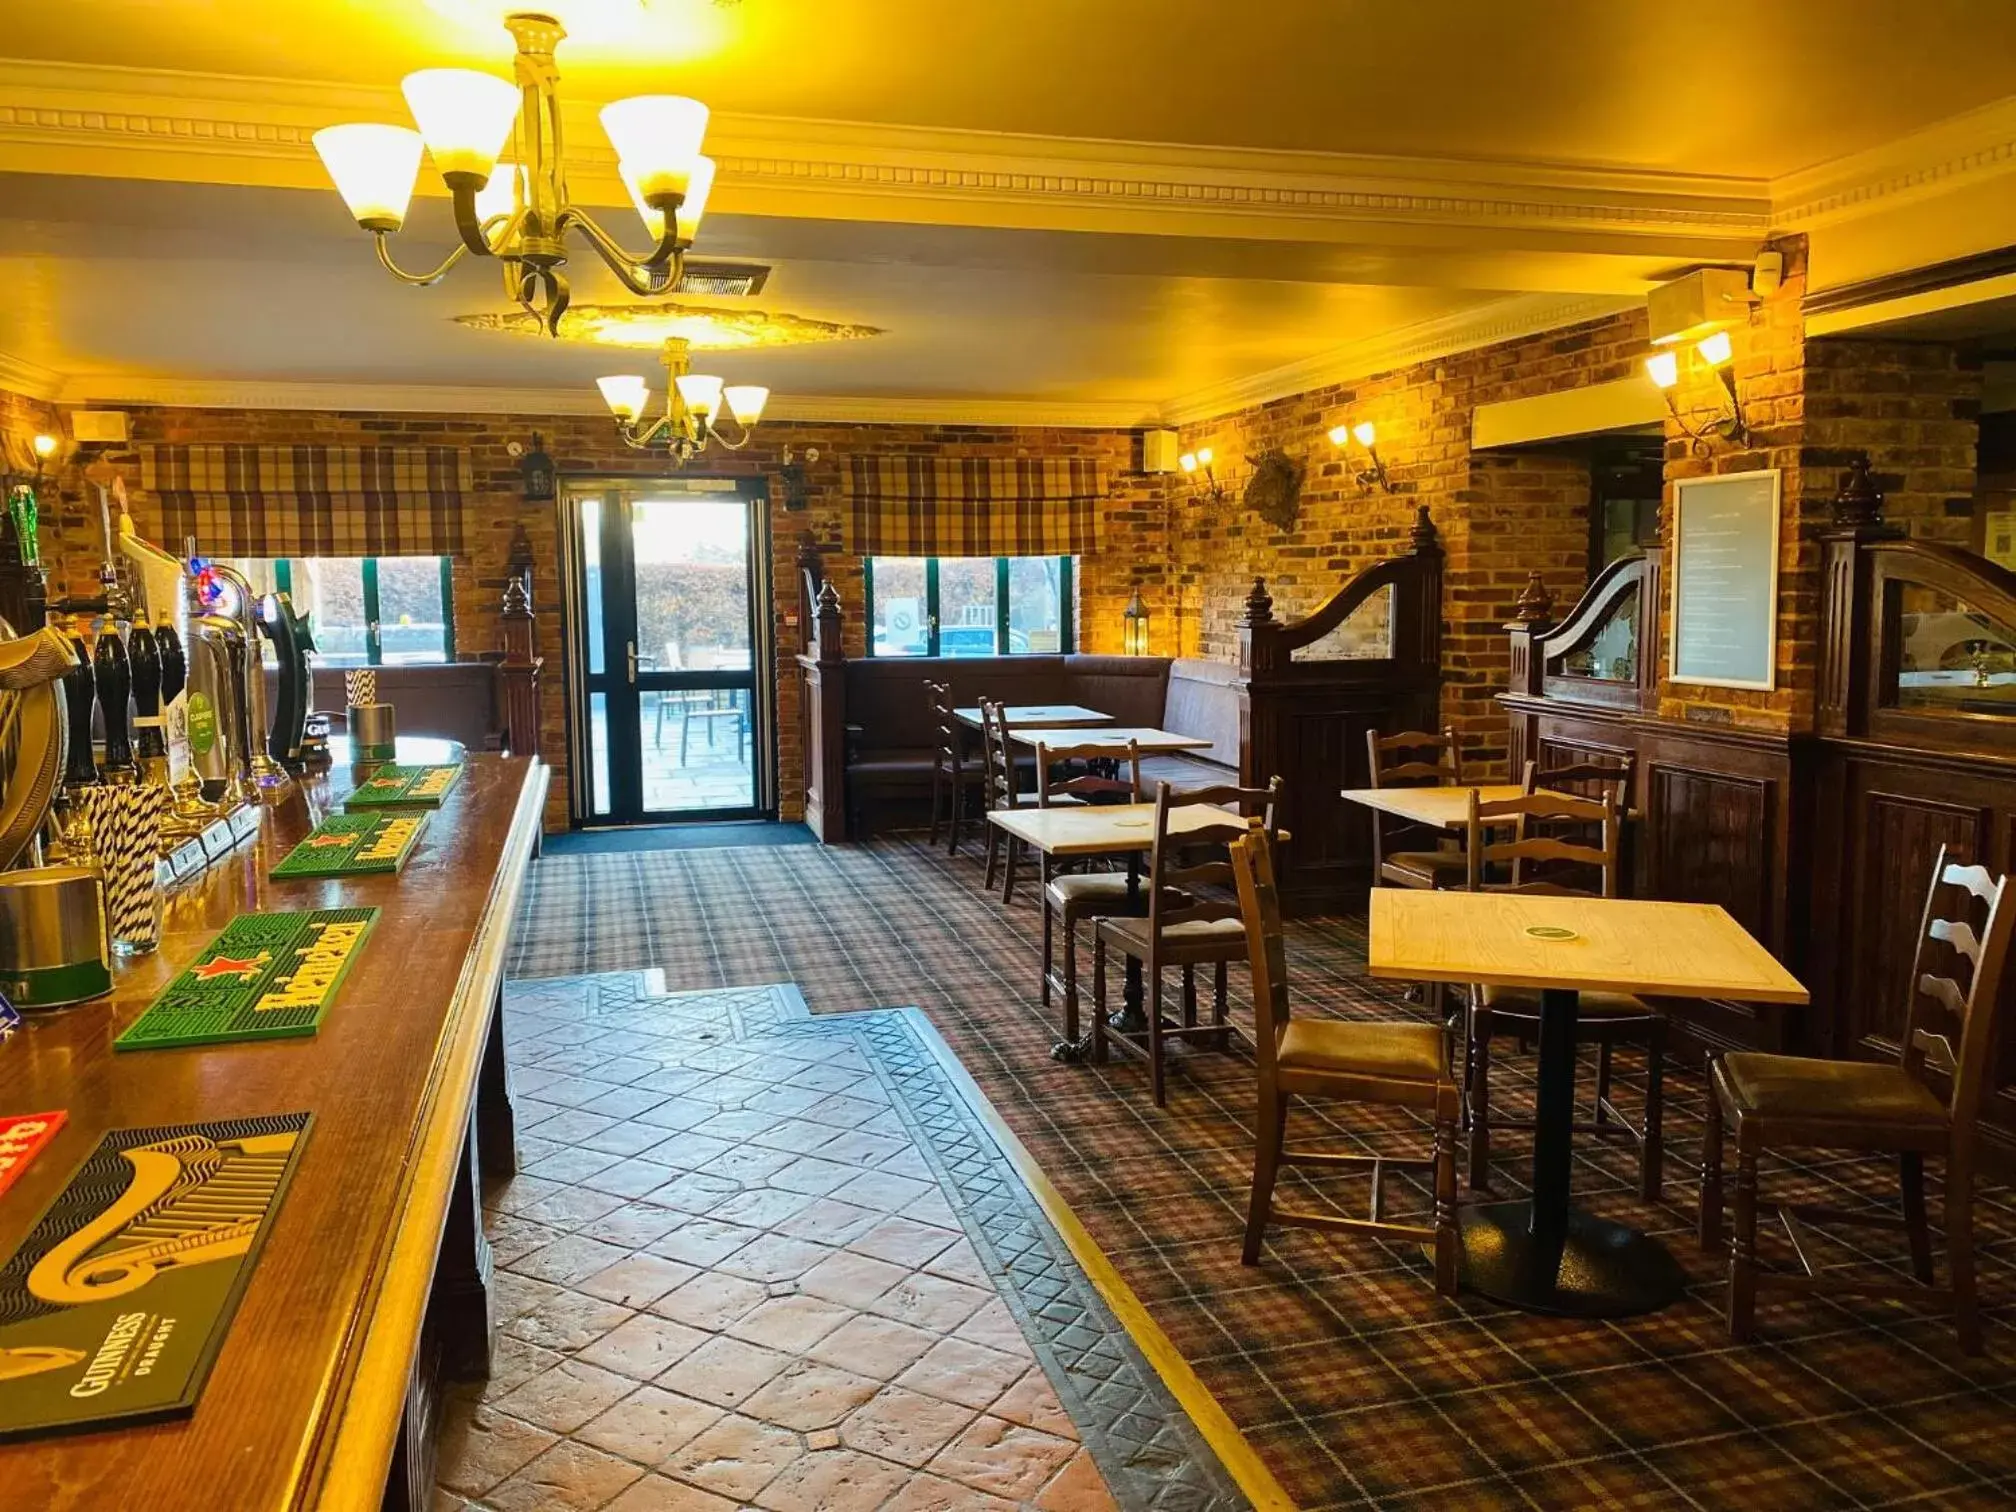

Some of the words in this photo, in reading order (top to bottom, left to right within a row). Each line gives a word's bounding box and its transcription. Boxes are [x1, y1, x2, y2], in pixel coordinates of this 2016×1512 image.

[354, 817, 421, 862] Heineken
[254, 920, 368, 1012] Heineken
[70, 1312, 146, 1398] GUINNESS
[134, 1318, 178, 1377] DRAUGHT
